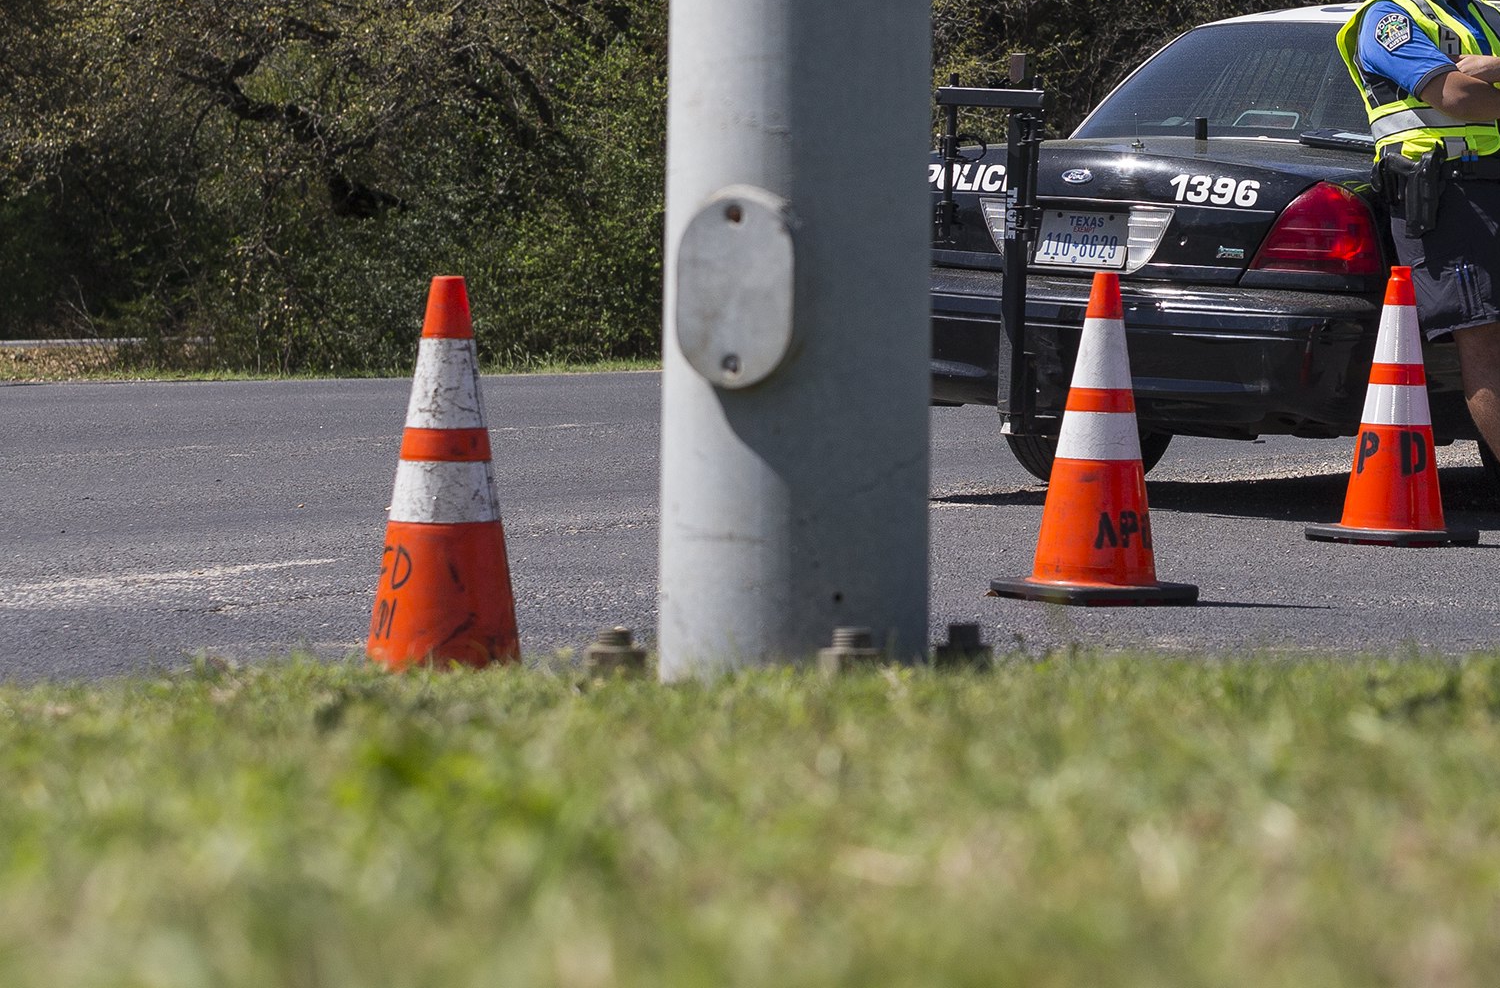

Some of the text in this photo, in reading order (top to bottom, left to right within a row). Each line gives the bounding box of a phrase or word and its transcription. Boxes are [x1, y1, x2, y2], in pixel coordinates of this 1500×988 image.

[928, 164, 1007, 192] POLIC
[1170, 173, 1260, 208] 1396
[1070, 216, 1105, 228] TEXAS
